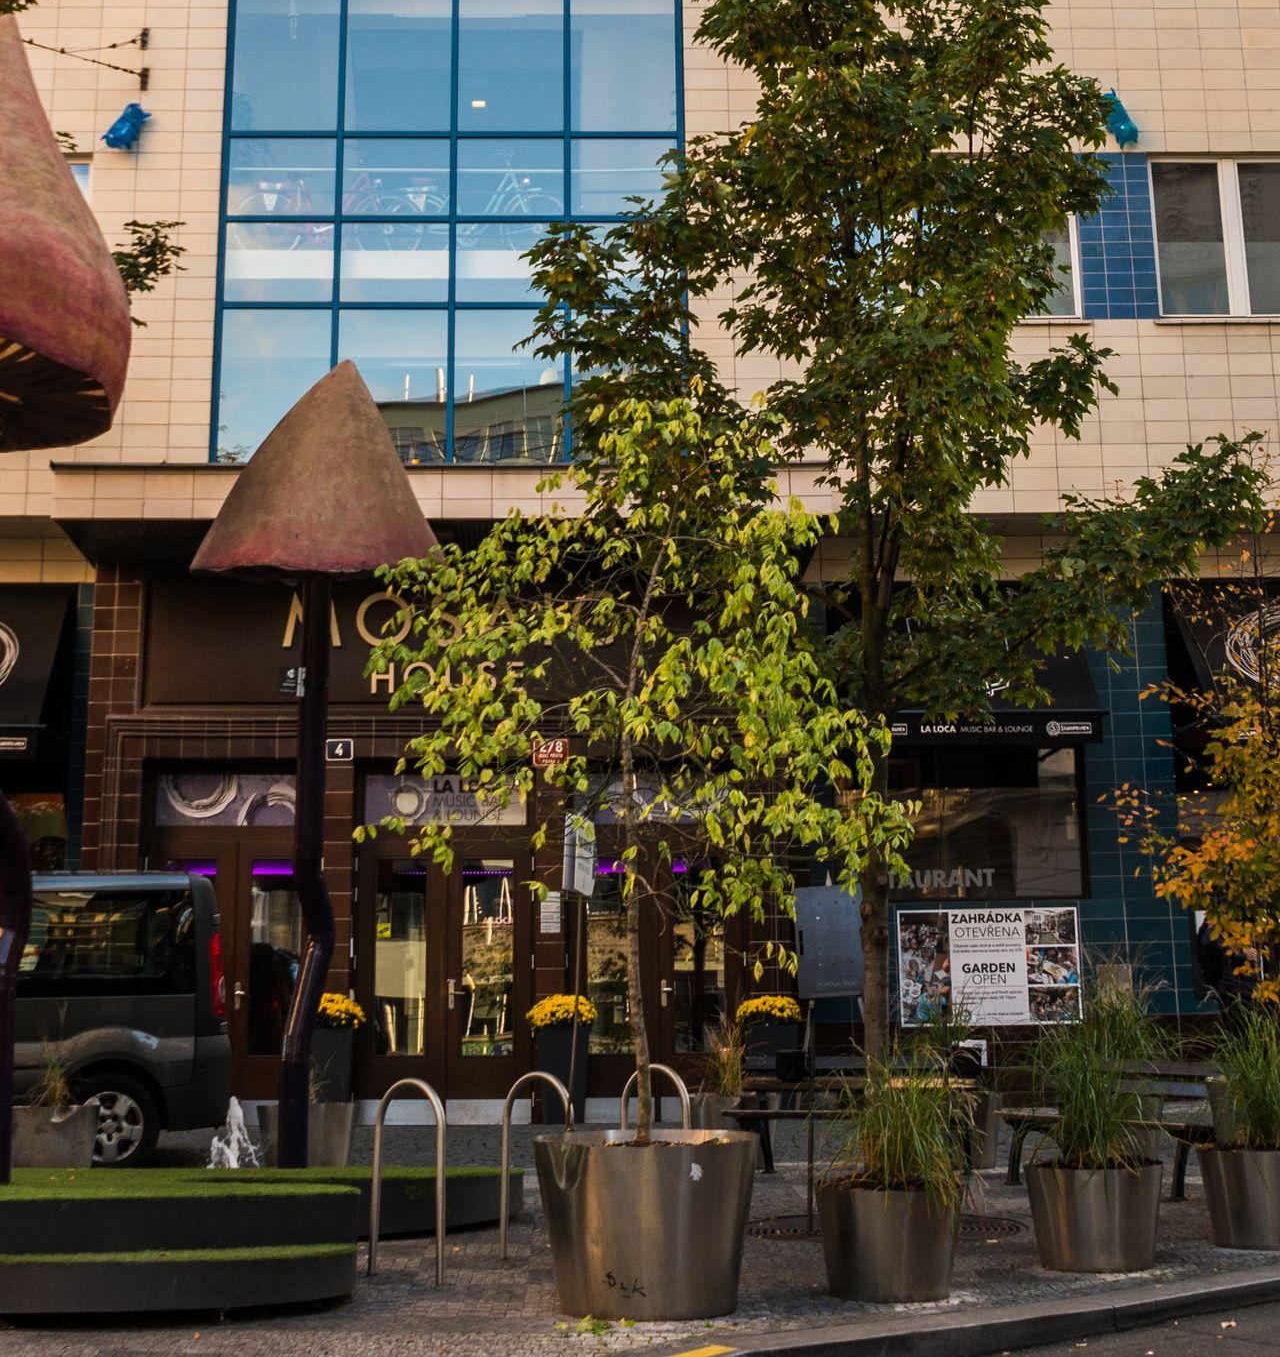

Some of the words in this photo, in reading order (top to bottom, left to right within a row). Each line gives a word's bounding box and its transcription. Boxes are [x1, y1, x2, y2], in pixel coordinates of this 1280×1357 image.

[920, 724, 933, 734] LA
[933, 724, 957, 734] LOCA
[960, 724, 982, 733] MUSIC
[984, 724, 998, 733] BAR
[998, 724, 1004, 733] &
[1005, 724, 1034, 733] LOUNGE
[334, 742, 344, 756] 4
[433, 779, 453, 794] LA
[433, 794, 475, 808] MUSIC
[447, 808, 505, 821] LOUNGE
[888, 868, 995, 890] TAURANT
[951, 911, 1022, 924] ZAHRÁDKA
[955, 924, 1020, 939] OTEVŘENA
[962, 962, 1016, 974] GARDEN
[972, 974, 1007, 985] OPEN
